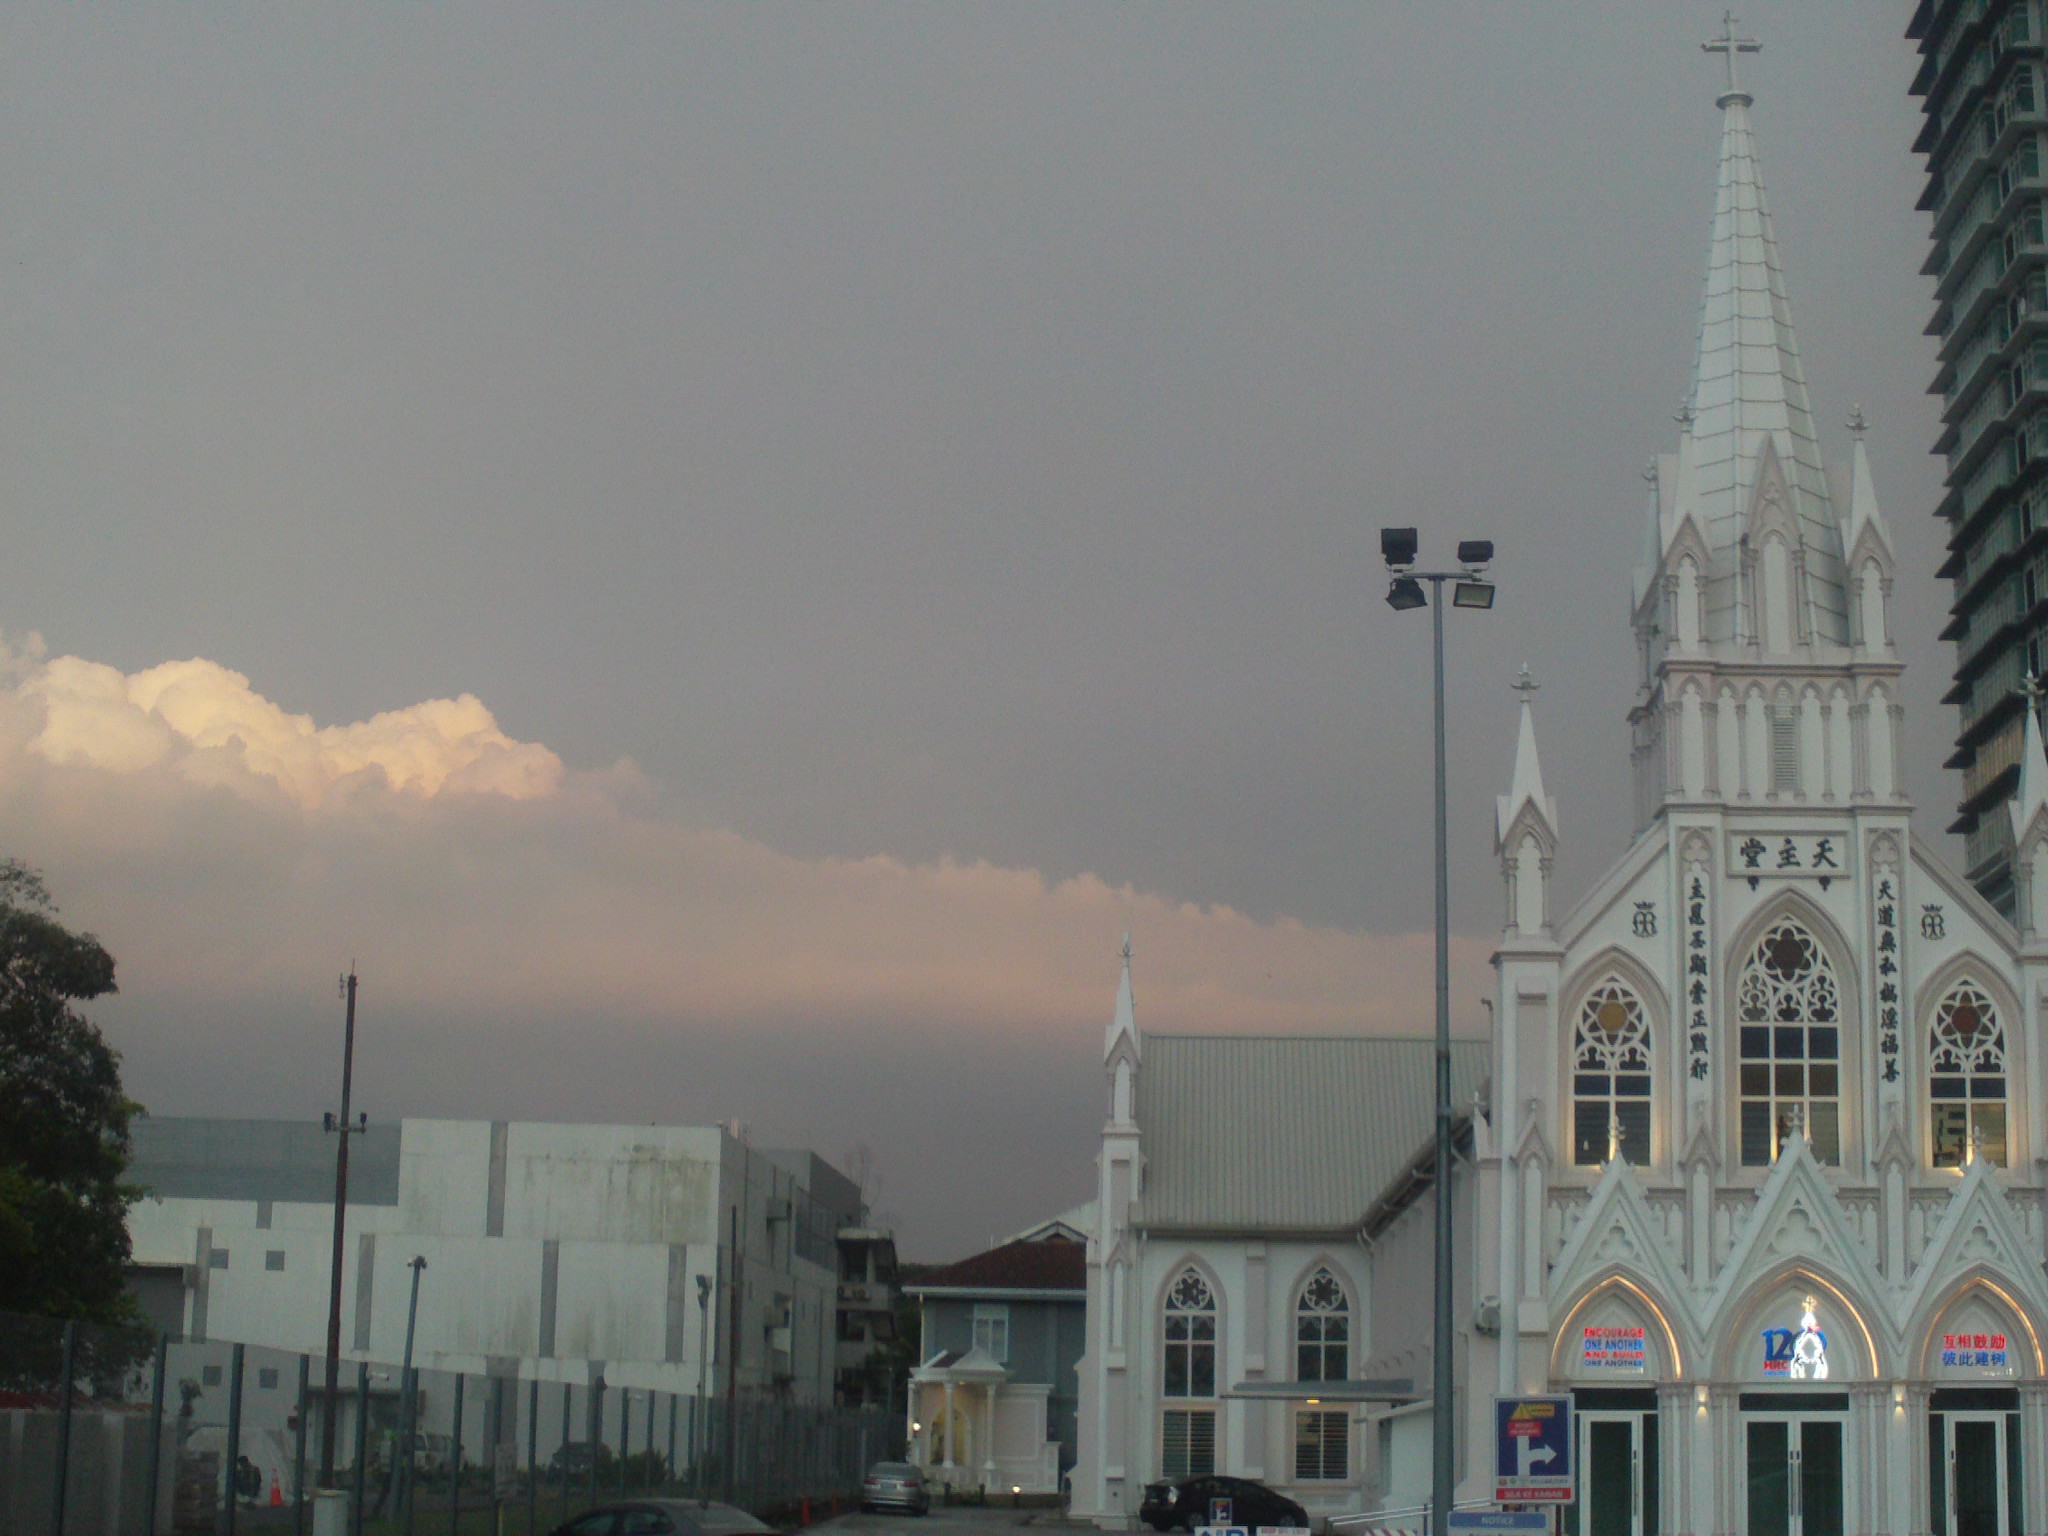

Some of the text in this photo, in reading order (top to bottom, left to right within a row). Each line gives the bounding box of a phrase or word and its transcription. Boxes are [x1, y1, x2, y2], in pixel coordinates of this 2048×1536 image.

[1584, 1328, 1644, 1338] ENCOURAGE
[1584, 1339, 1602, 1350] ONE
[1943, 1334, 2006, 1350] 互相鼓励
[1943, 1351, 2006, 1367] 彼此建树
[1482, 1516, 1515, 1526] NOTICE
